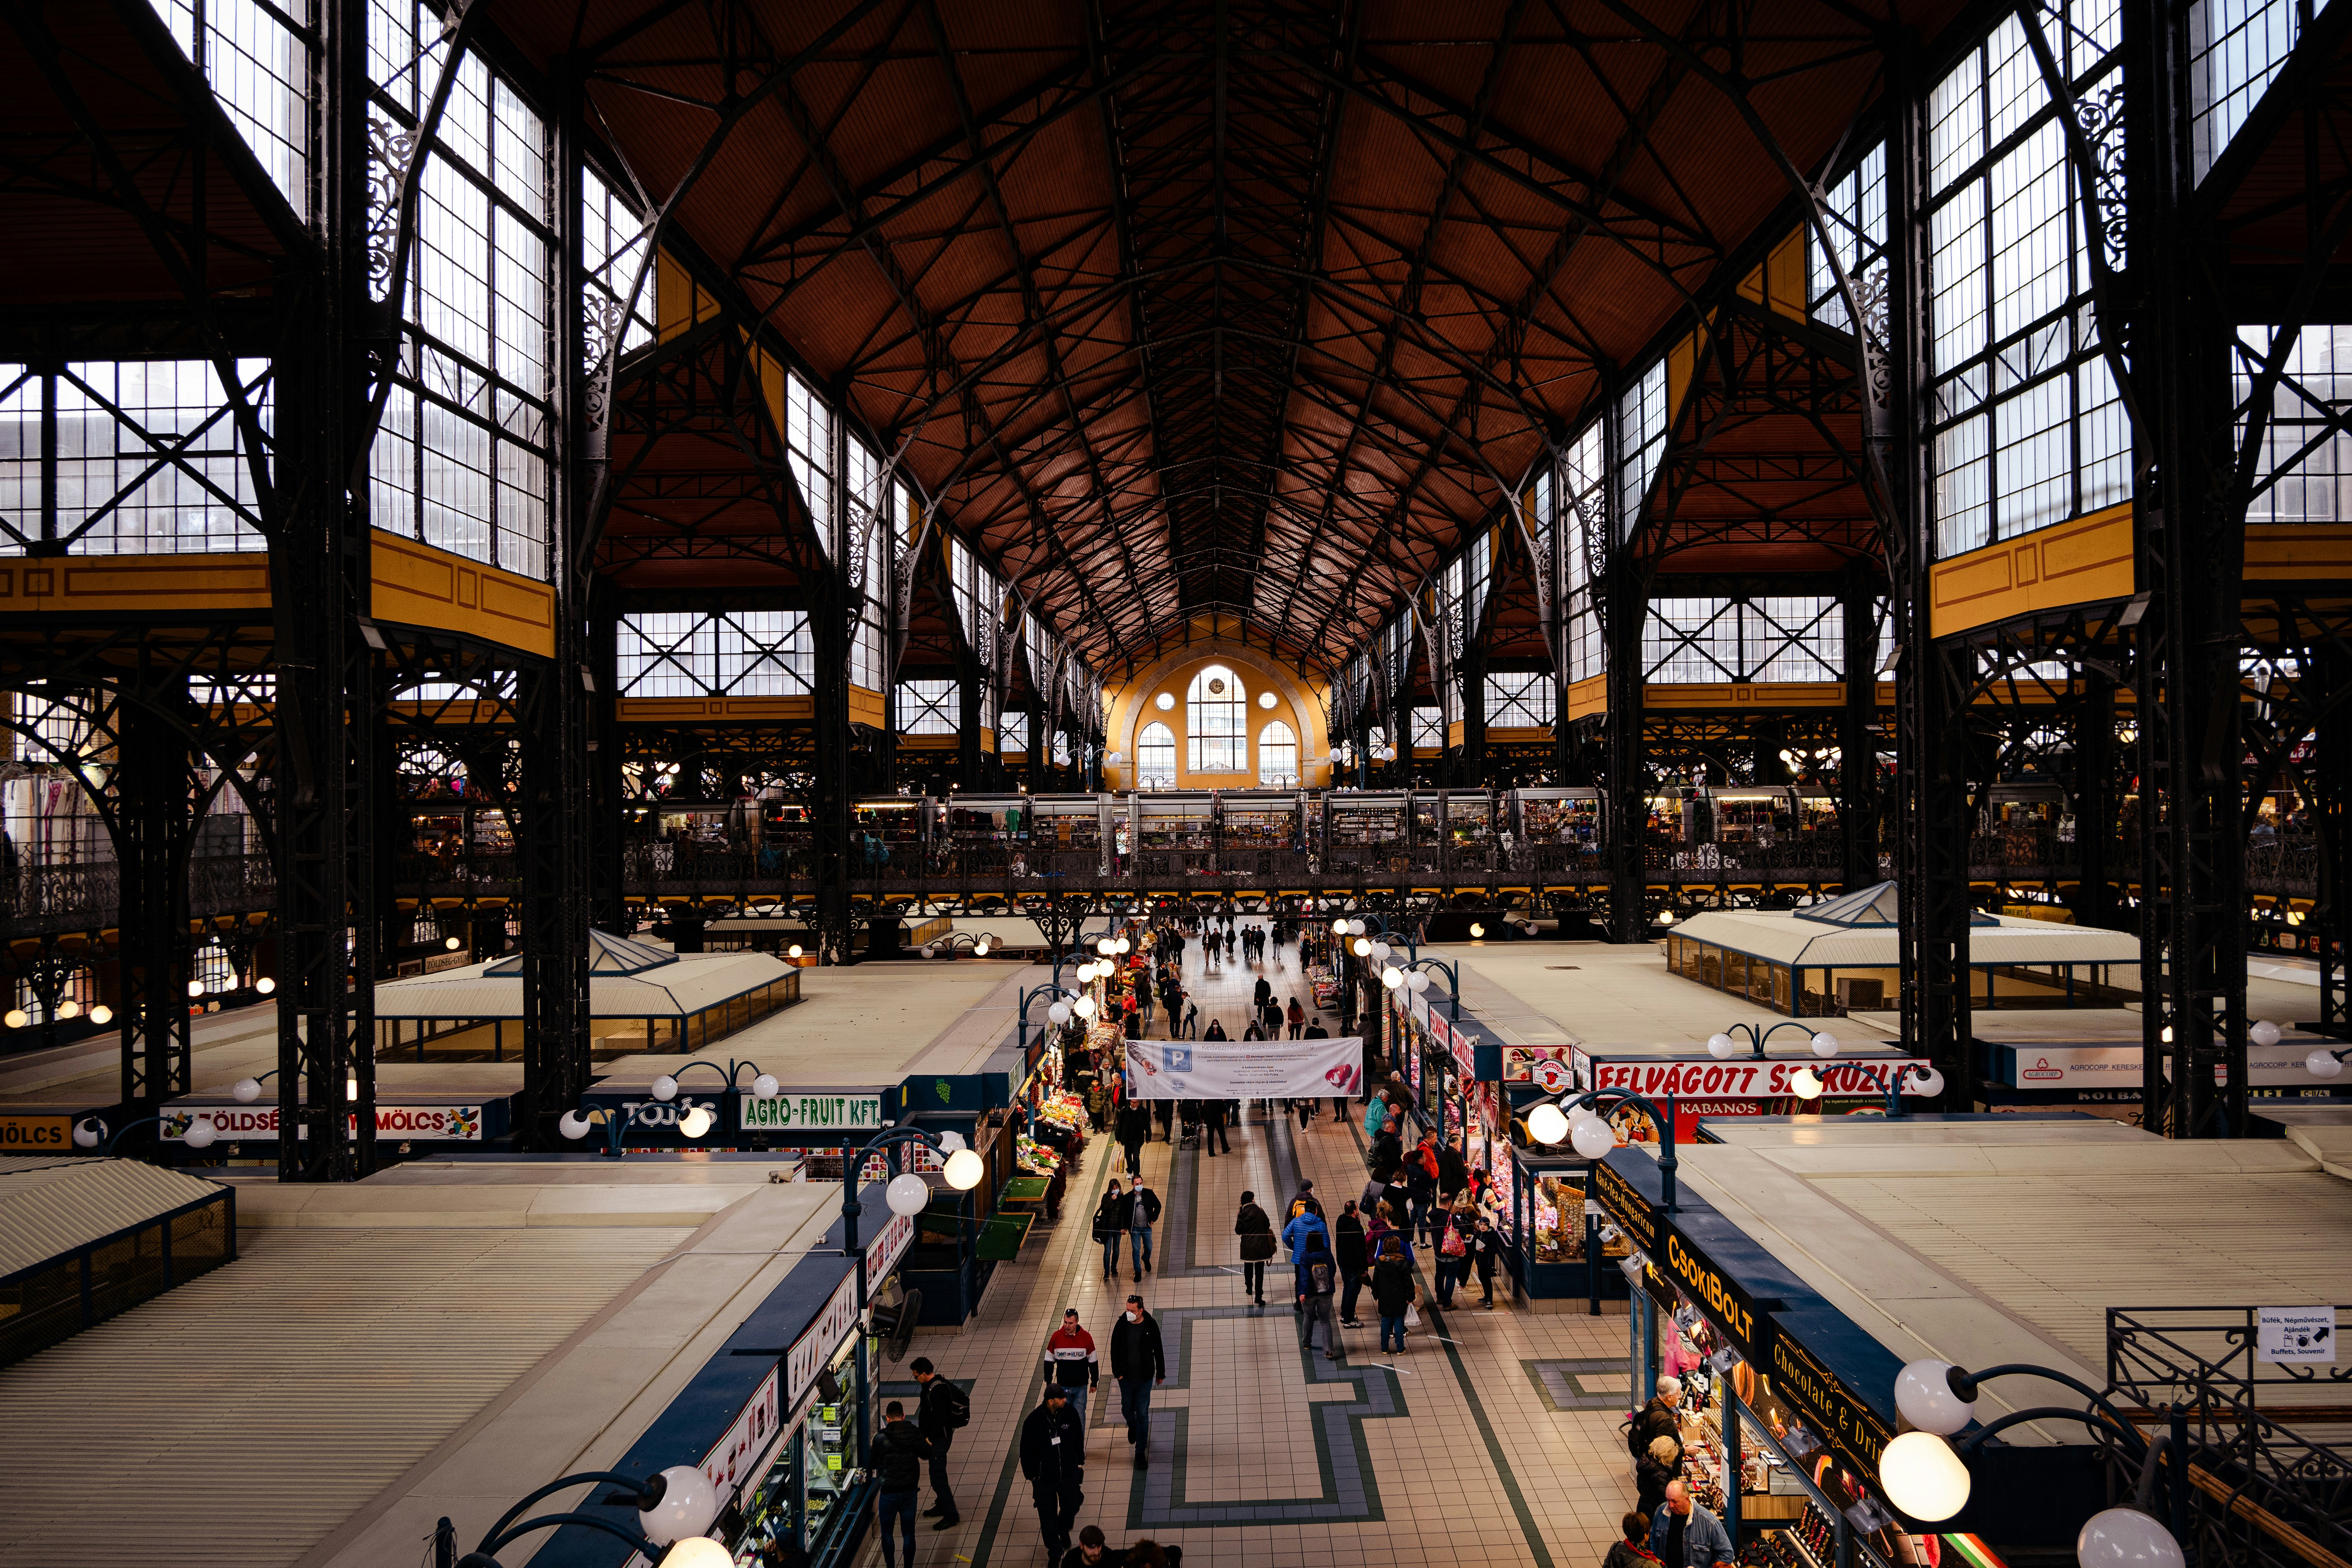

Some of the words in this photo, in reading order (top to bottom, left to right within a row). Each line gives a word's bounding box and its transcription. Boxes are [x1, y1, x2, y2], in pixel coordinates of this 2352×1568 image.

[1172, 1051, 1184, 1066] P
[1452, 1029, 1474, 1074] SZAKÜZLE
[1541, 1063, 1563, 1073] KABANOS
[1598, 1063, 1758, 1094] FELVÁGOTT
[2078, 1090, 2142, 1100] KOLBÁ
[745, 1098, 845, 1126] AGRO-FRUIT
[849, 1099, 881, 1126] KFT.
[1681, 1102, 1757, 1114] KABANOS
[0, 1122, 62, 1144] ÖLCS
[2284, 1316, 2329, 1324] Népművészet,
[1774, 1344, 1833, 1414] Chocolate
[1838, 1407, 1848, 1430] &
